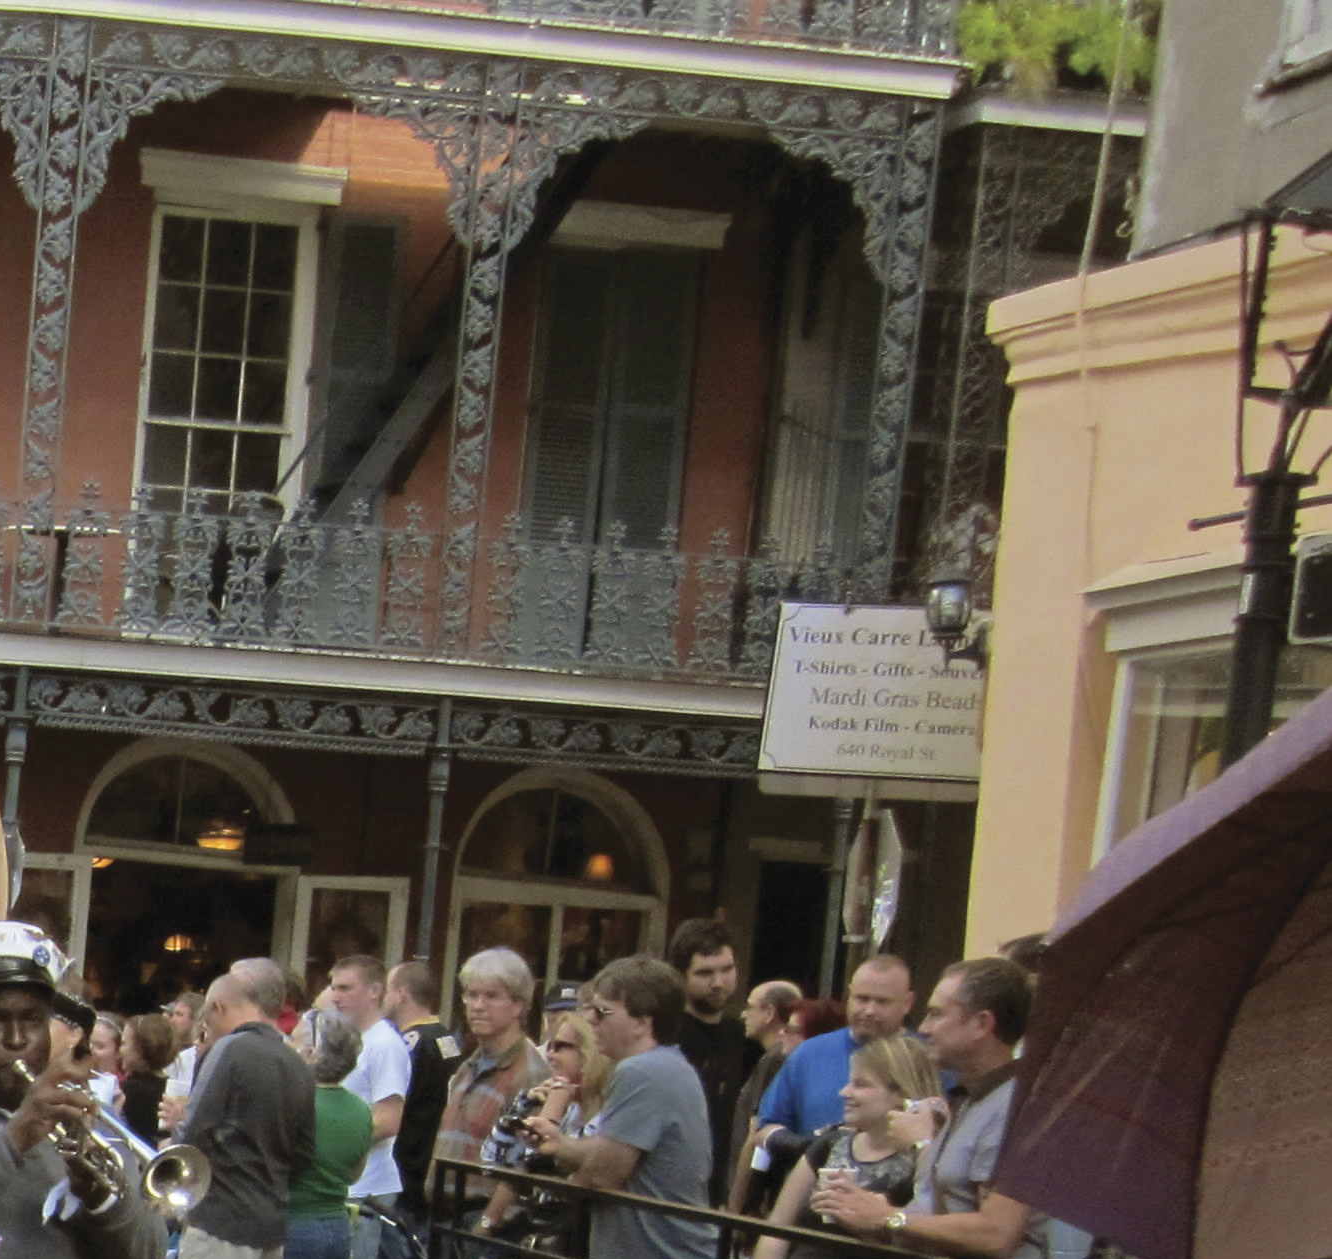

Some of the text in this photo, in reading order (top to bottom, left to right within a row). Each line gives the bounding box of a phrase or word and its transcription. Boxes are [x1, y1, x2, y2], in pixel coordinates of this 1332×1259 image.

[789, 626, 844, 645] Vieux
[852, 627, 912, 646] Carre
[794, 660, 856, 676] T-Shirts
[873, 662, 914, 677] Gifts
[809, 686, 866, 707] Mardi
[874, 688, 919, 709] Gras
[808, 716, 858, 731] Kodak
[864, 717, 899, 732] Film
[836, 743, 865, 758] 640
[869, 744, 913, 763] Royal
